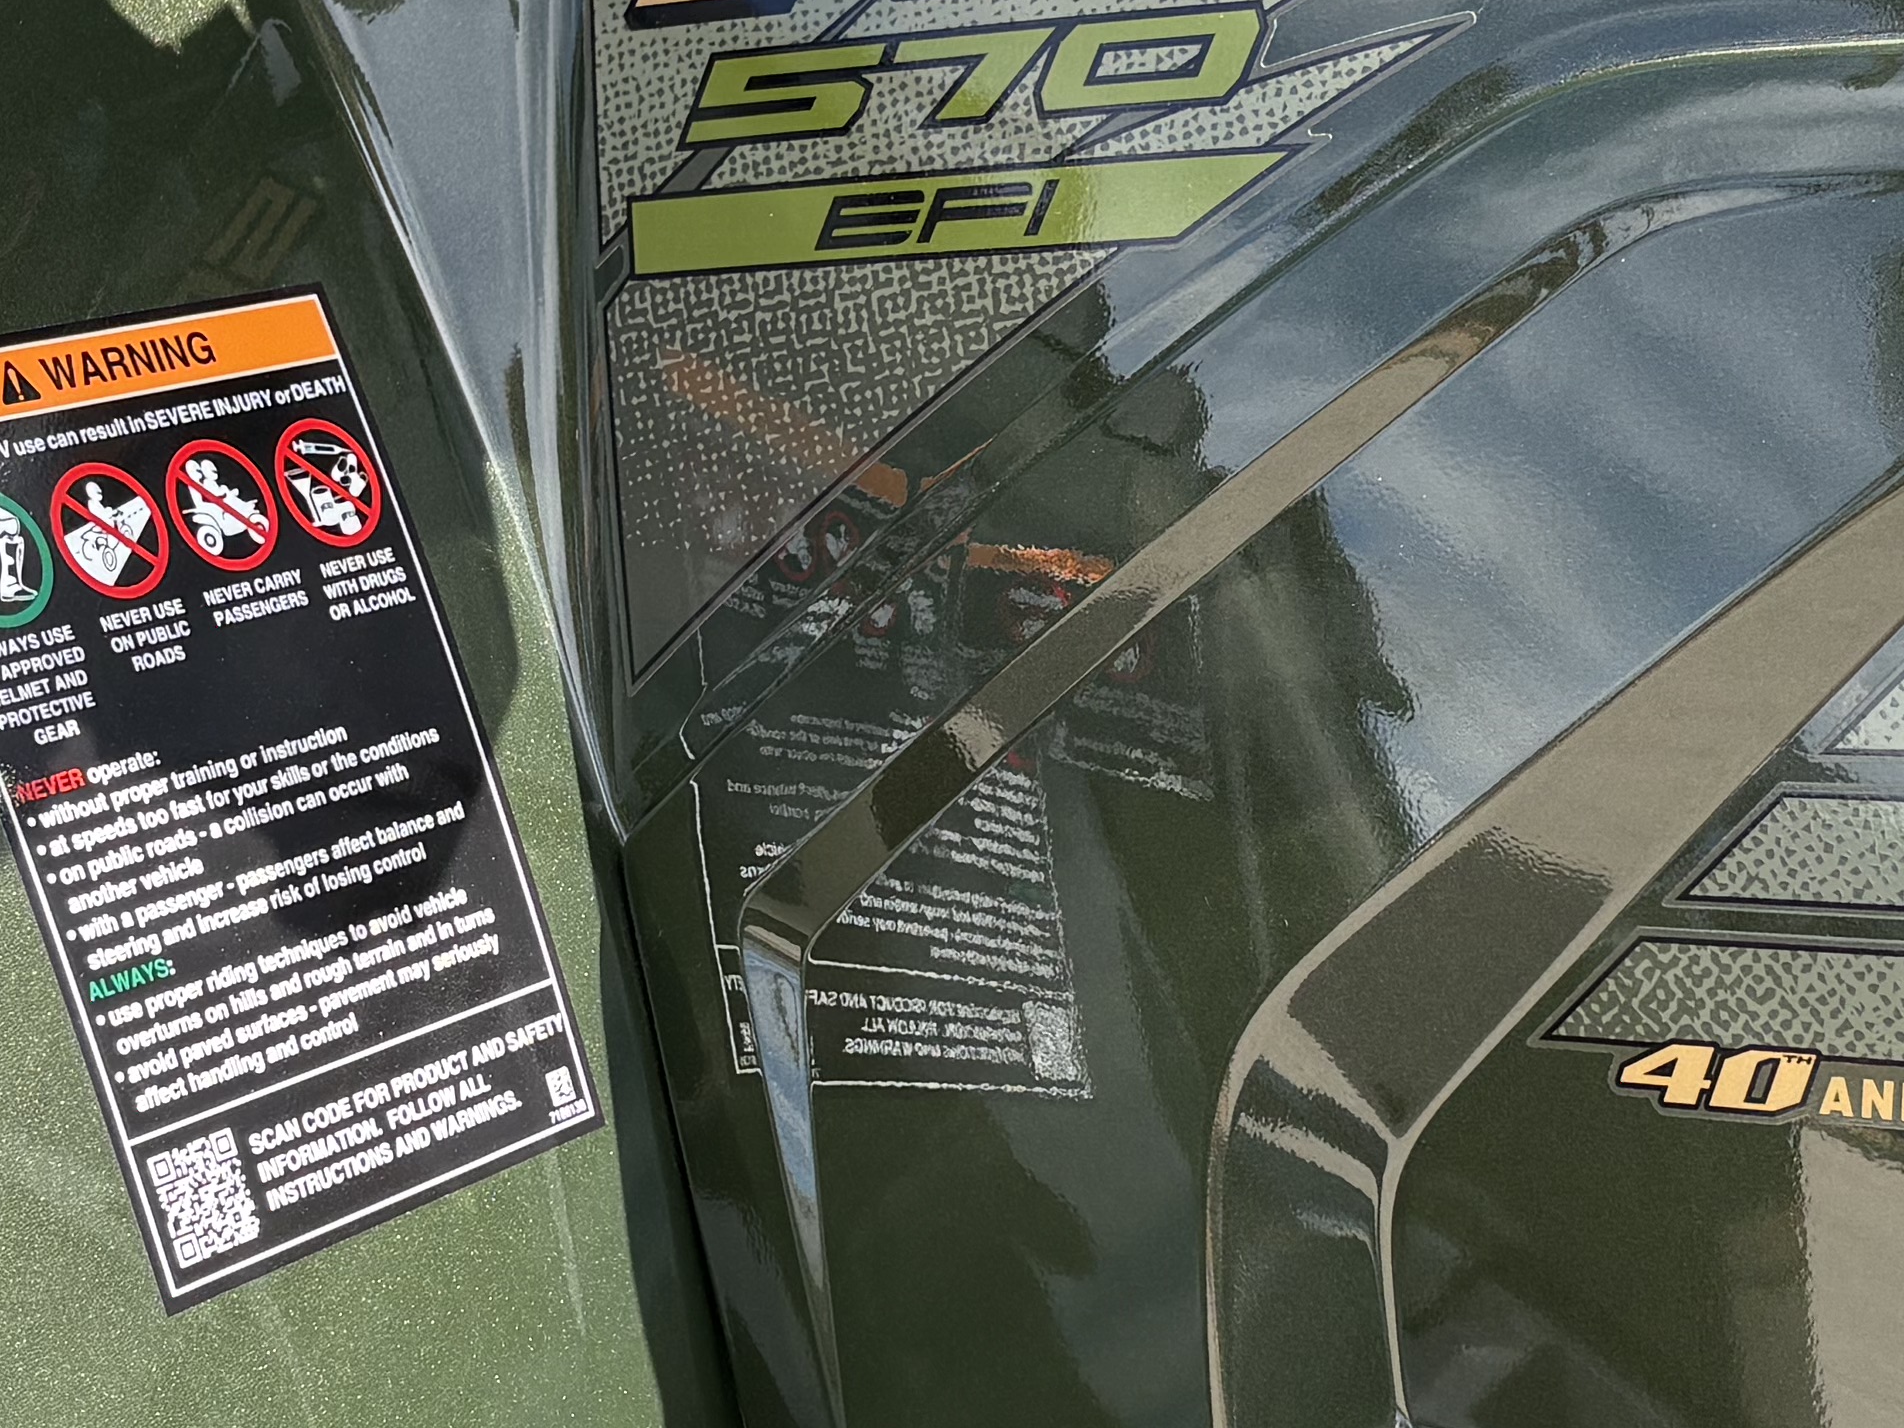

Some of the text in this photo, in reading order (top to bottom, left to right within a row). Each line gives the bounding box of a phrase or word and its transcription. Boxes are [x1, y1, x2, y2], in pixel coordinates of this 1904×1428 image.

[688, 9, 1266, 146] 570
[816, 177, 1057, 250] EFI
[38, 331, 217, 391] WARNING
[12, 437, 47, 457] use
[46, 430, 80, 450] can
[79, 417, 130, 444] result
[126, 415, 147, 434] in
[143, 400, 215, 430] SEVERE
[211, 388, 272, 417] INJURY
[274, 389, 291, 405] or
[289, 374, 347, 402] DEATH
[202, 568, 302, 607] NEVER CARRY
[319, 547, 396, 579] NEVER USE
[322, 566, 407, 600] WITH DRUGS
[99, 598, 186, 633] NEVER USE
[212, 590, 309, 627] PASSENGERS
[329, 586, 417, 621] OR ALCOHOL
[40, 624, 76, 646] USE
[110, 620, 191, 653] ON PUBLIC
[131, 644, 186, 672] ROADS
[0, 646, 86, 681] APPROVED
[55, 669, 88, 692] AND
[33, 719, 81, 746] GEAR
[16, 750, 162, 804] NEVER operate:
[37, 726, 348, 829] without proper training or instruction
[48, 727, 440, 858] at speeds too fast for your skills or the conditions
[77, 800, 466, 942] with a passenger passengers affect balance and
[89, 958, 177, 1002] ALWAYS:
[107, 887, 468, 1027] use proper riding techniques to avoid vehicle
[126, 933, 500, 1084] avoid paved surfaces pavement may seriously
[134, 1012, 359, 1113] affect handling and control
[248, 1012, 563, 1155] SCAN CODE FOR PRODUCT AND SAFETY
[256, 1073, 492, 1184] INFORMATION. FOLLOW ALL
[265, 1141, 394, 1212] INSTRUCTIONS
[395, 1126, 431, 1158] AND
[429, 1089, 523, 1141] WARNINGS.
